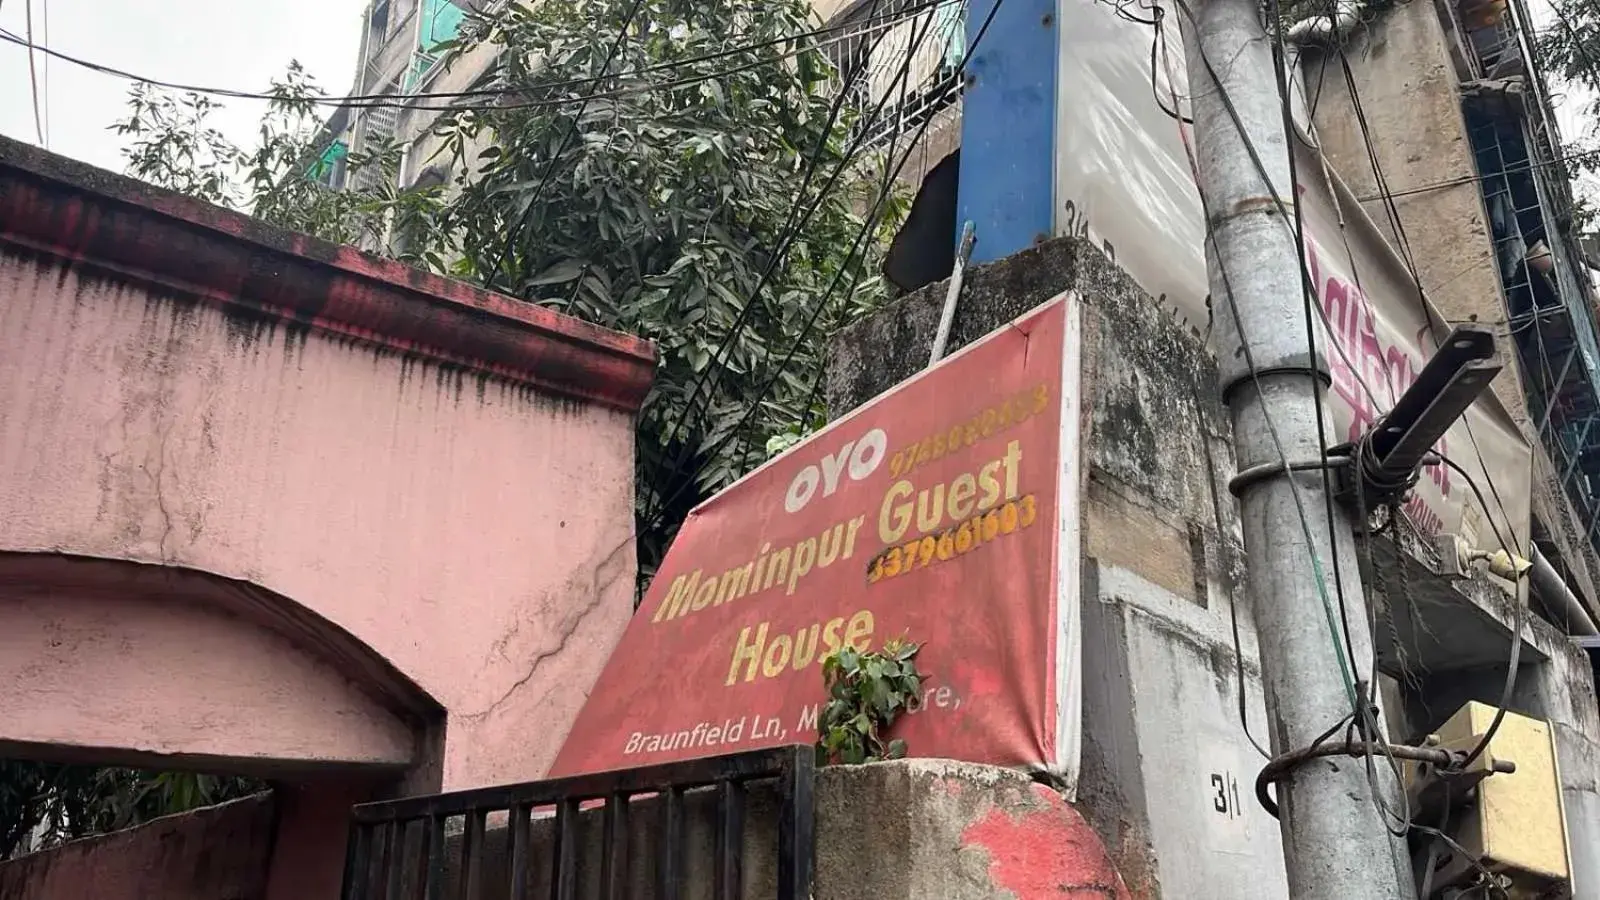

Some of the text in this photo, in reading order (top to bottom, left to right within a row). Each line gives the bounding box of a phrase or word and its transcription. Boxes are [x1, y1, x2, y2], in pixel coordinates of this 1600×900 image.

[785, 428, 887, 513] OYO
[652, 440, 1022, 623] Mominpur Guest
[724, 609, 875, 687] House
[624, 716, 746, 754] Braunfield
[751, 714, 788, 741] Ln,
